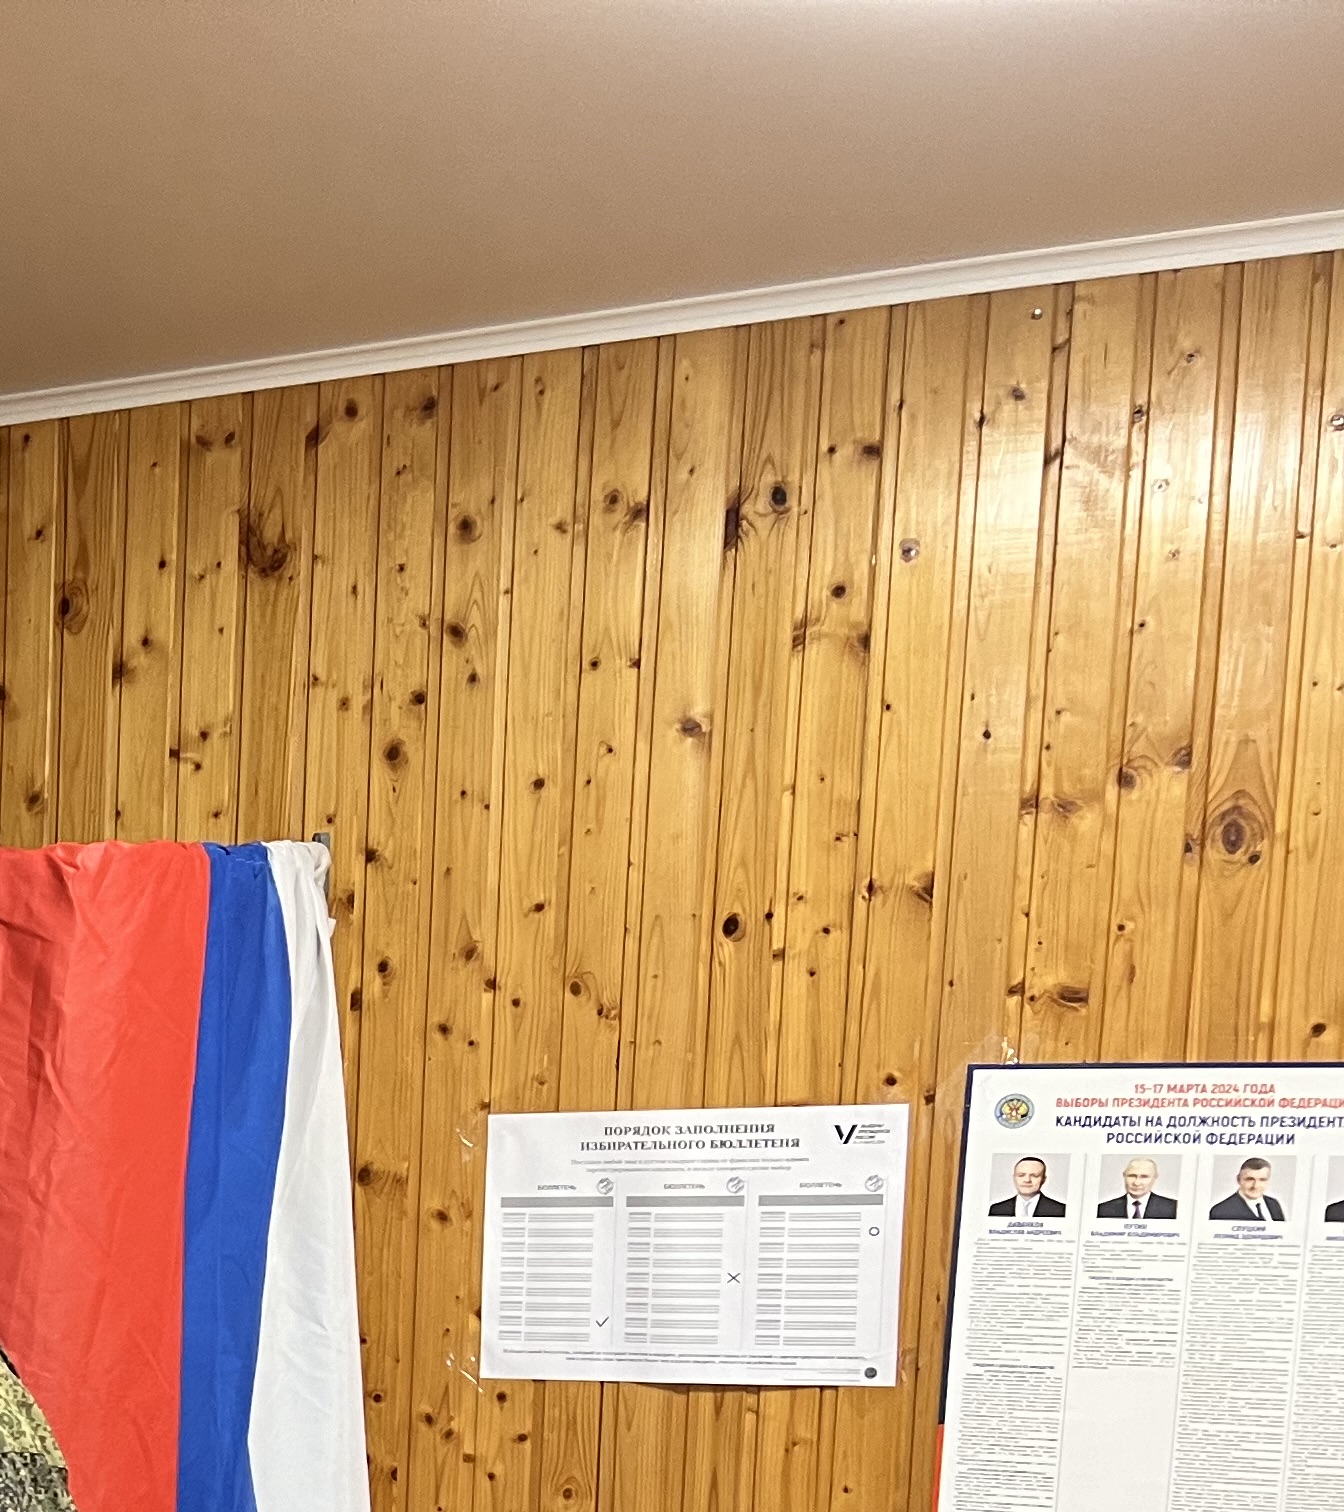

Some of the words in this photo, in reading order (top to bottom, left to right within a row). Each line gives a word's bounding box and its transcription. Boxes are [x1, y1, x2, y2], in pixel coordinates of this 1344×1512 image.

[1166, 1083, 1208, 1094] МАРТА
[1210, 1083, 1240, 1094] 2024
[1242, 1083, 1276, 1095] ГОДА
[1055, 1097, 1109, 1108] ВЫБОРЫ
[1112, 1097, 1190, 1109] ПРЕЗИДЕНТА
[1192, 1095, 1276, 1108] РОССИЙСКОЙ
[1055, 1115, 1141, 1129] КАНДИДАТЫ
[1145, 1115, 1164, 1127] НА
[1166, 1115, 1256, 1129] ДОЛЖНОСТЬ
[1259, 1115, 1344, 1129] ПРЕЗИДЕНТ
[604, 1125, 671, 1137] ПОРЯДОК
[674, 1124, 776, 1136] ЗАПОЛНЕНИЯ
[580, 1139, 706, 1152] ИЗБИРАТЕЛЬНОГО
[709, 1138, 801, 1151] БЮЛЛЕТЕНЯ
[1106, 1130, 1201, 1145] РОССИЙСКОЙ
[1205, 1132, 1296, 1146] ФЕДЕРАЦИИ
